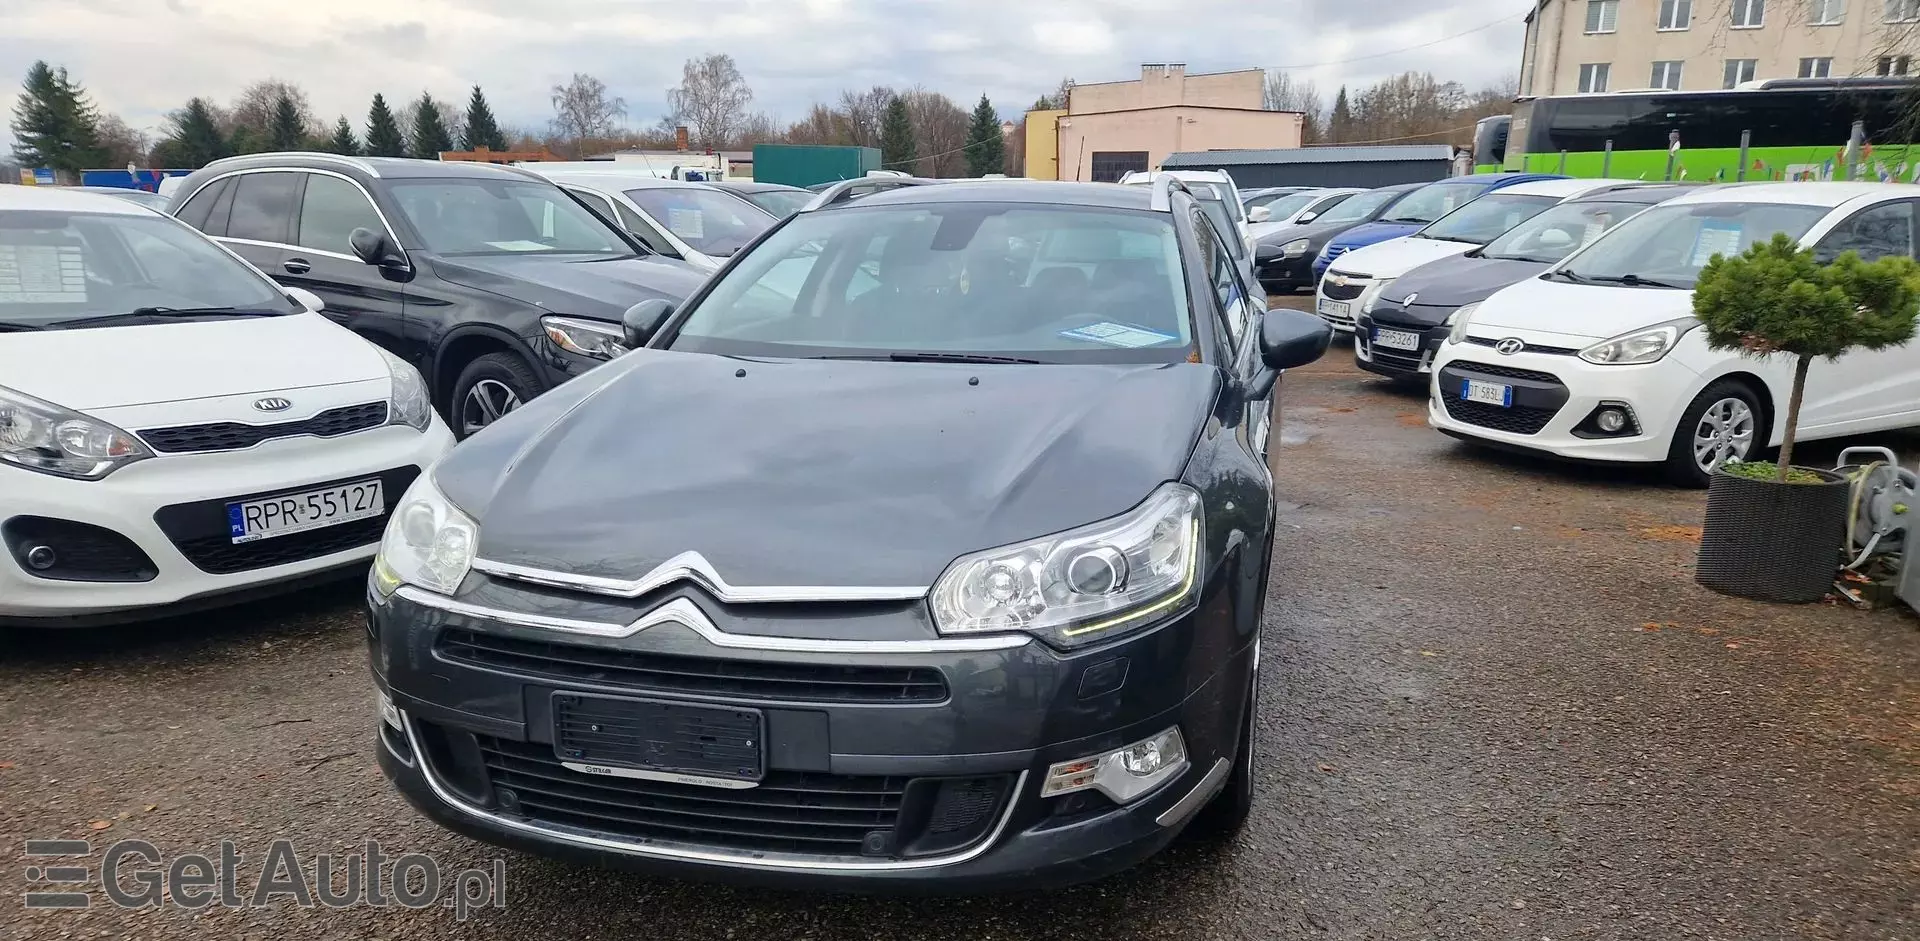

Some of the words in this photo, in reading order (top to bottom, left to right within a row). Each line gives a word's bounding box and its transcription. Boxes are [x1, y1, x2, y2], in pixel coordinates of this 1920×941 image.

[258, 399, 289, 410] KIA
[245, 499, 299, 532] RPR
[307, 483, 379, 520] 55127
[232, 524, 243, 532] PL
